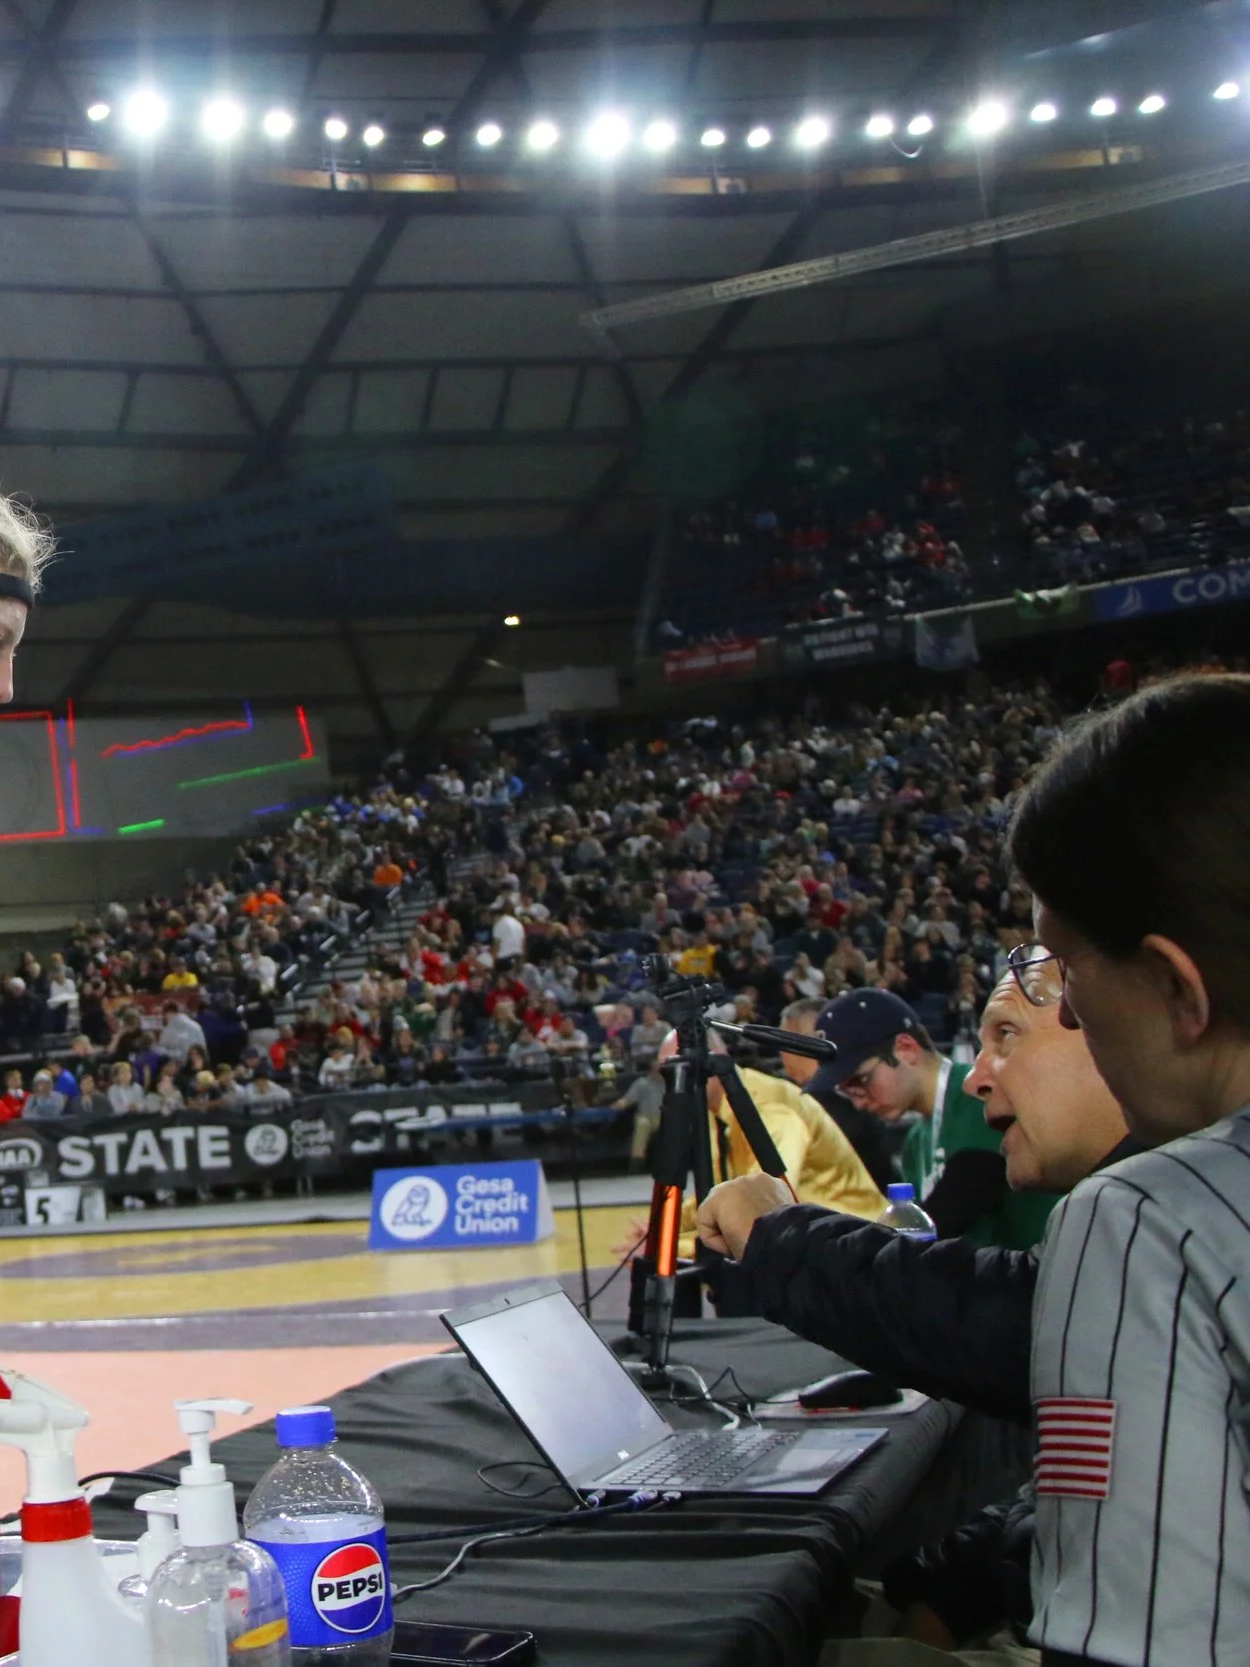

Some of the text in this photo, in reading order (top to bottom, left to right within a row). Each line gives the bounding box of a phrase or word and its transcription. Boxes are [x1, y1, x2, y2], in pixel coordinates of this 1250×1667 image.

[59, 1127, 232, 1177] STATE
[456, 1175, 513, 1194] Gesa
[455, 1192, 531, 1216] Credit
[454, 1213, 520, 1235] Union
[317, 1571, 383, 1602] PEPSI
